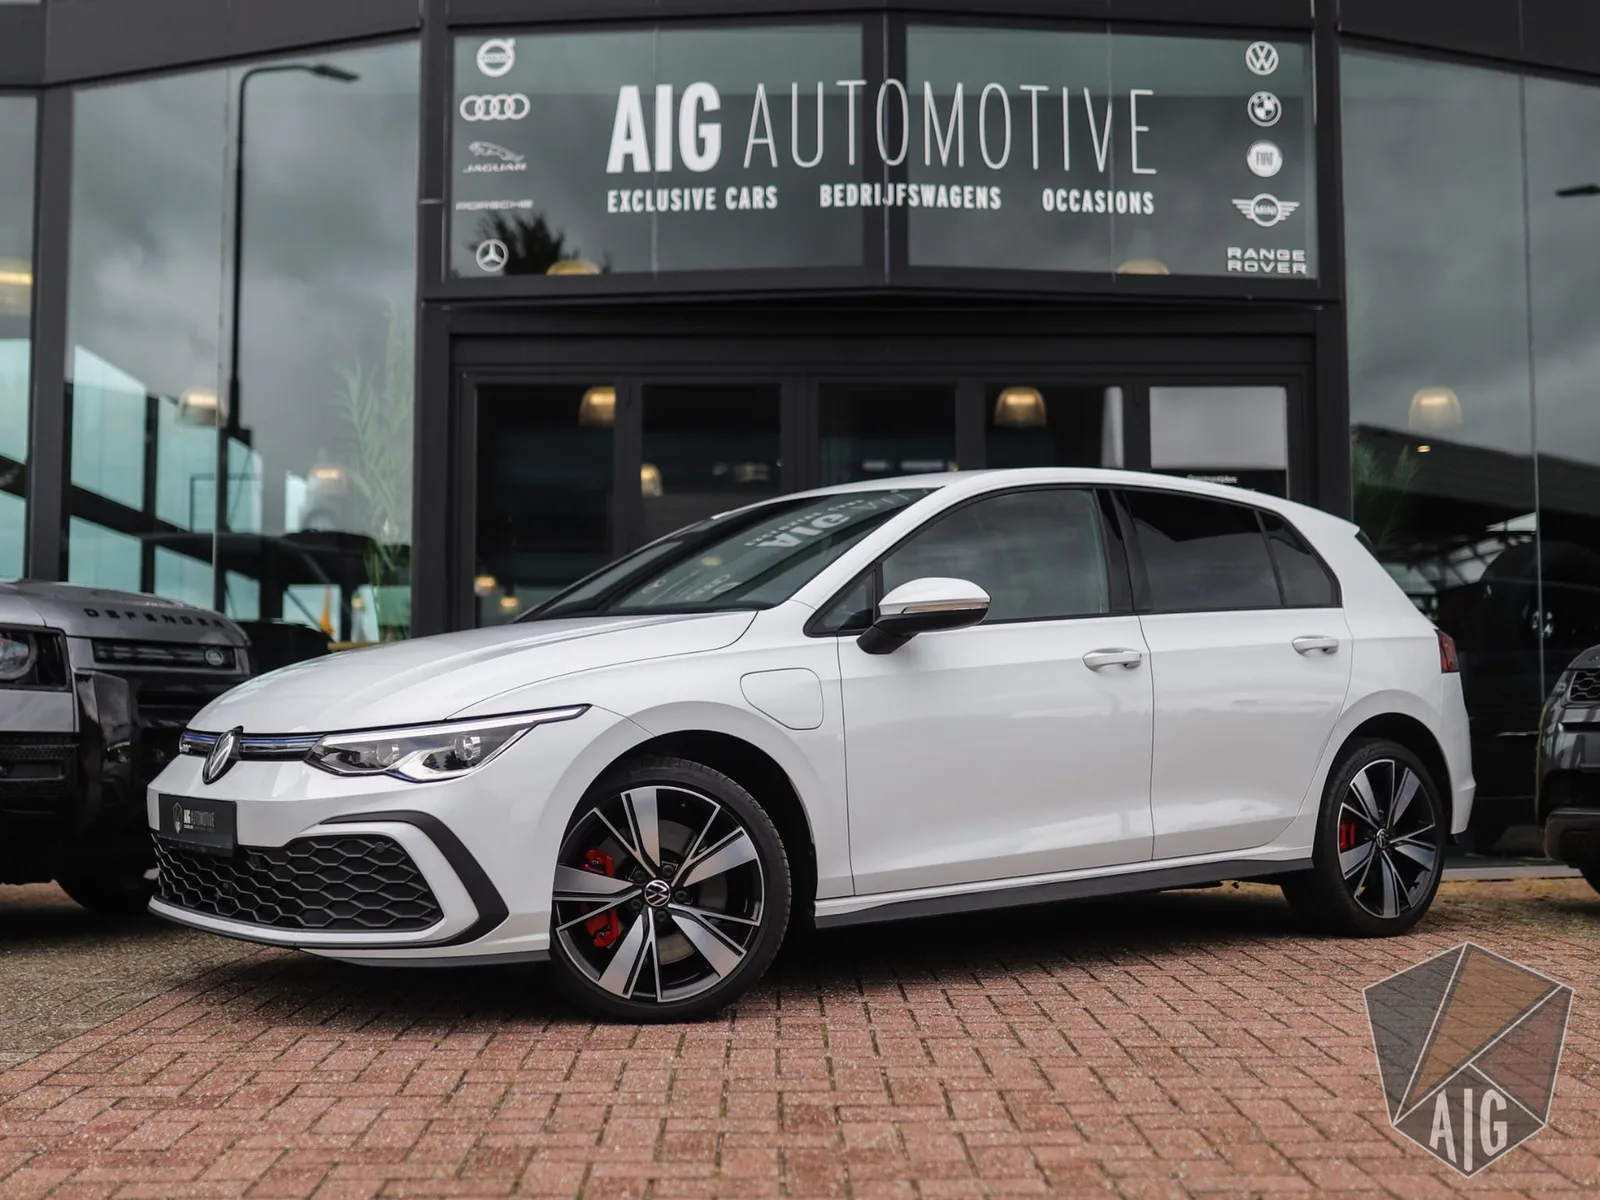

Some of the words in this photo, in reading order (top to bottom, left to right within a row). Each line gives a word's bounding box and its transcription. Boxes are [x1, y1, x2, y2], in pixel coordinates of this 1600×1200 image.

[606, 82, 721, 173] AIG
[744, 79, 1157, 174] AUTOMOTIVE
[607, 187, 717, 213] EXCLUSIVE
[725, 185, 778, 210] CARS
[819, 183, 1002, 210] BEDRIJFSWAGENS
[1042, 188, 1155, 215] OCCASIONS
[1227, 247, 1306, 262] RANGE
[1227, 259, 1307, 274] ROVER
[83, 608, 225, 627] DEFENDER
